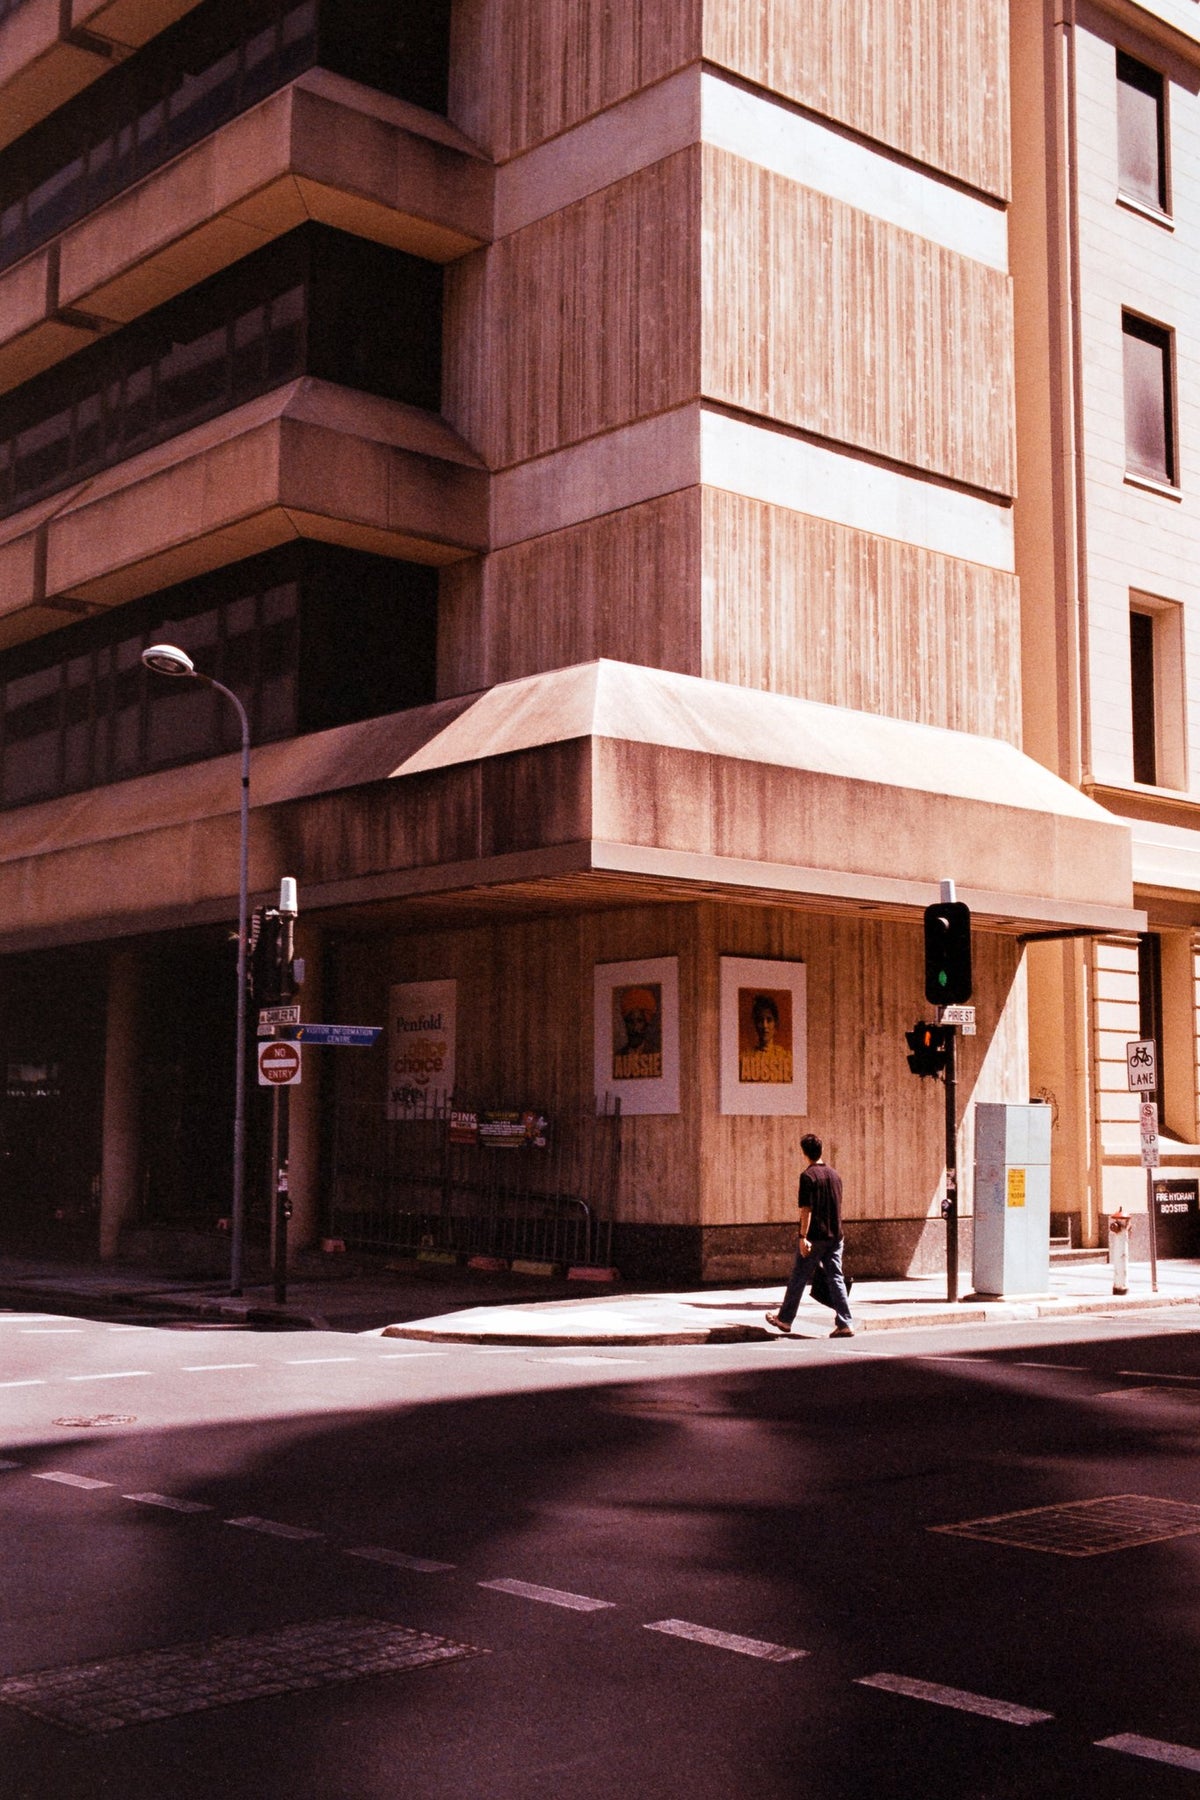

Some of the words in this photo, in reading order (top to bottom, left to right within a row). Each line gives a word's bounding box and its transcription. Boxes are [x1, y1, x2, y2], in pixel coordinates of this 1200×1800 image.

[948, 1010, 963, 1021] PIRIE
[965, 1011, 973, 1021] ST
[396, 1013, 441, 1033] Penfold
[305, 1027, 330, 1035] VISITOR
[332, 1028, 373, 1036] INFORMATION
[326, 1035, 352, 1043] CENTRE
[274, 1047, 287, 1058] NO
[394, 1052, 443, 1074] choice
[614, 1053, 661, 1078] AUSSIE
[740, 1055, 793, 1082] AUSSIE
[267, 1069, 293, 1080] ENTRY
[1130, 1072, 1154, 1086] LANE
[451, 1112, 477, 1122] PINK
[1155, 1192, 1169, 1202] FIRE
[1169, 1191, 1195, 1201] HYDRANT
[1160, 1203, 1189, 1214] BOOSTER
